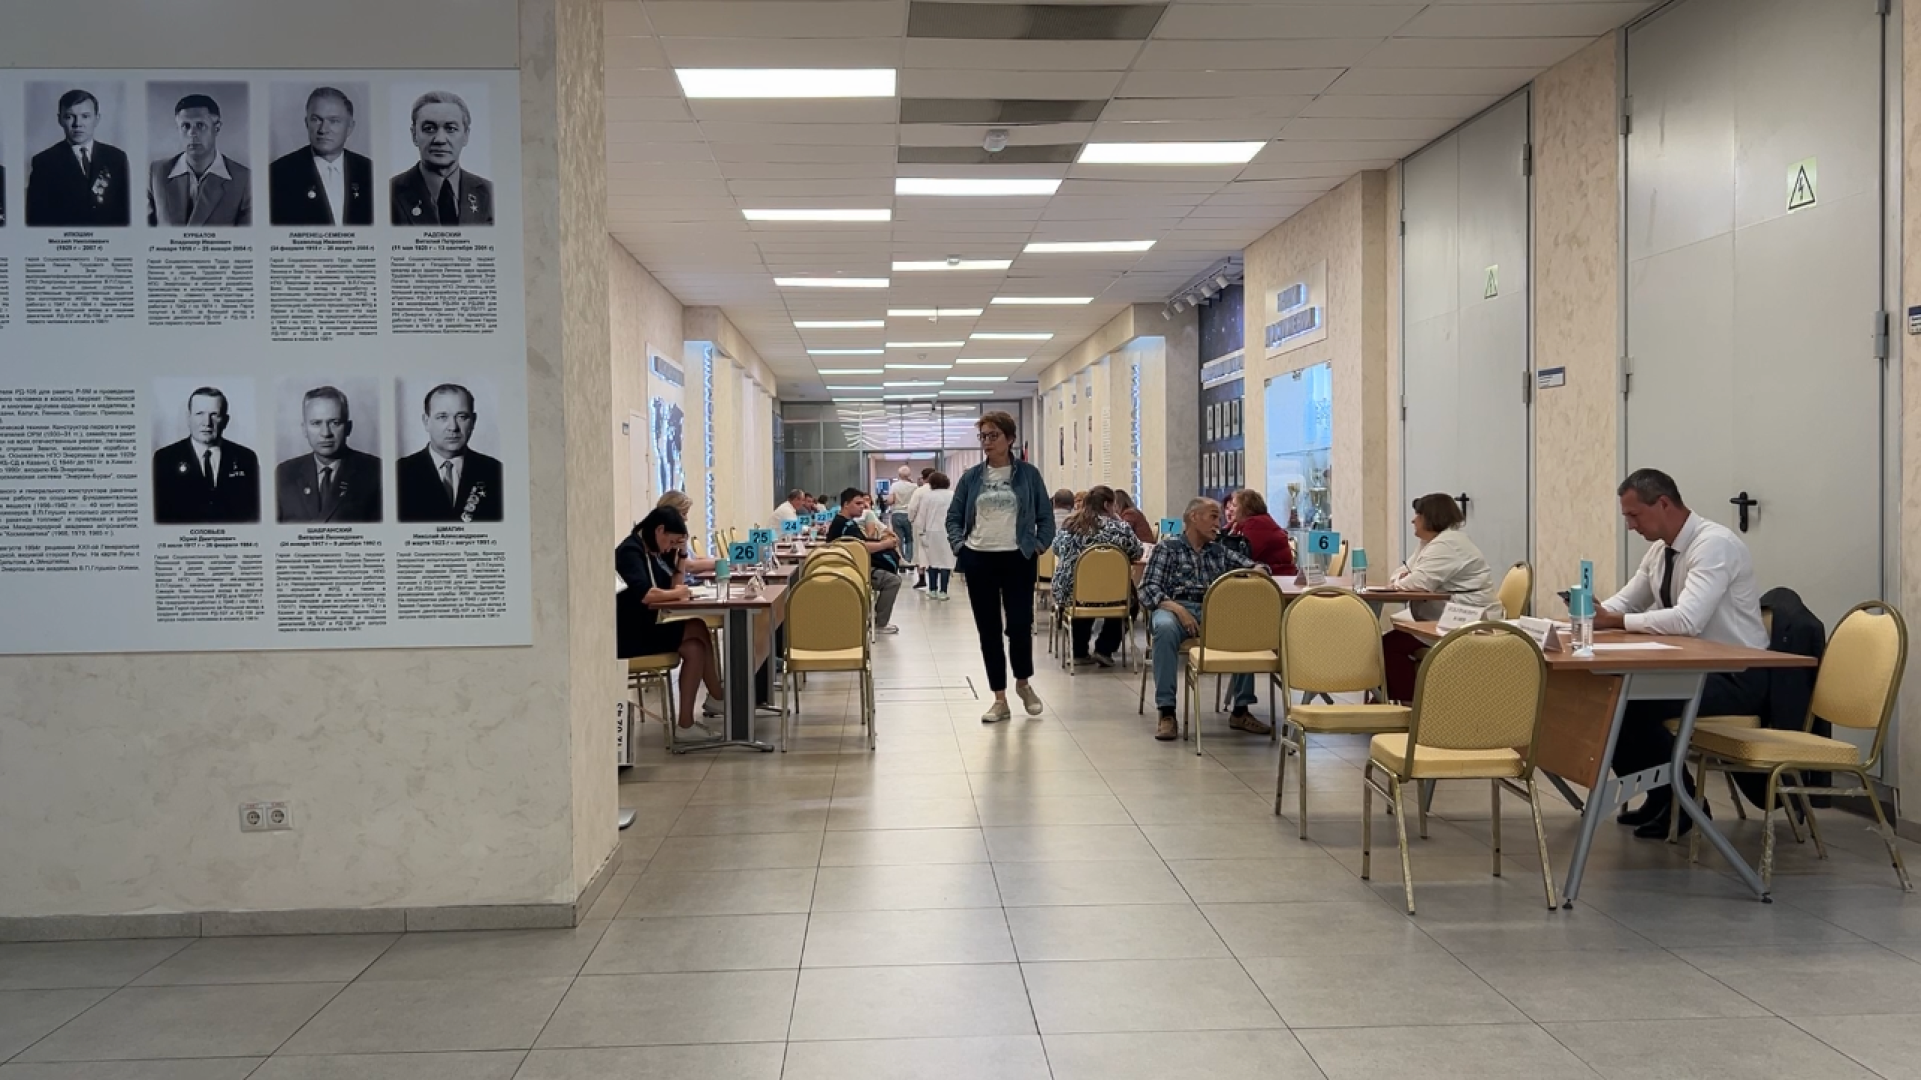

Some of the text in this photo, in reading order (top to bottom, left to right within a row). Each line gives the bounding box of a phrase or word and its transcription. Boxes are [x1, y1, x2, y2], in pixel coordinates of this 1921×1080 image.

[785, 522, 796, 530] 24
[1168, 522, 1174, 531] 7
[753, 532, 768, 543] 25
[1319, 536, 1328, 549] 6
[735, 546, 754, 560] 26
[1584, 568, 1589, 589] 5
